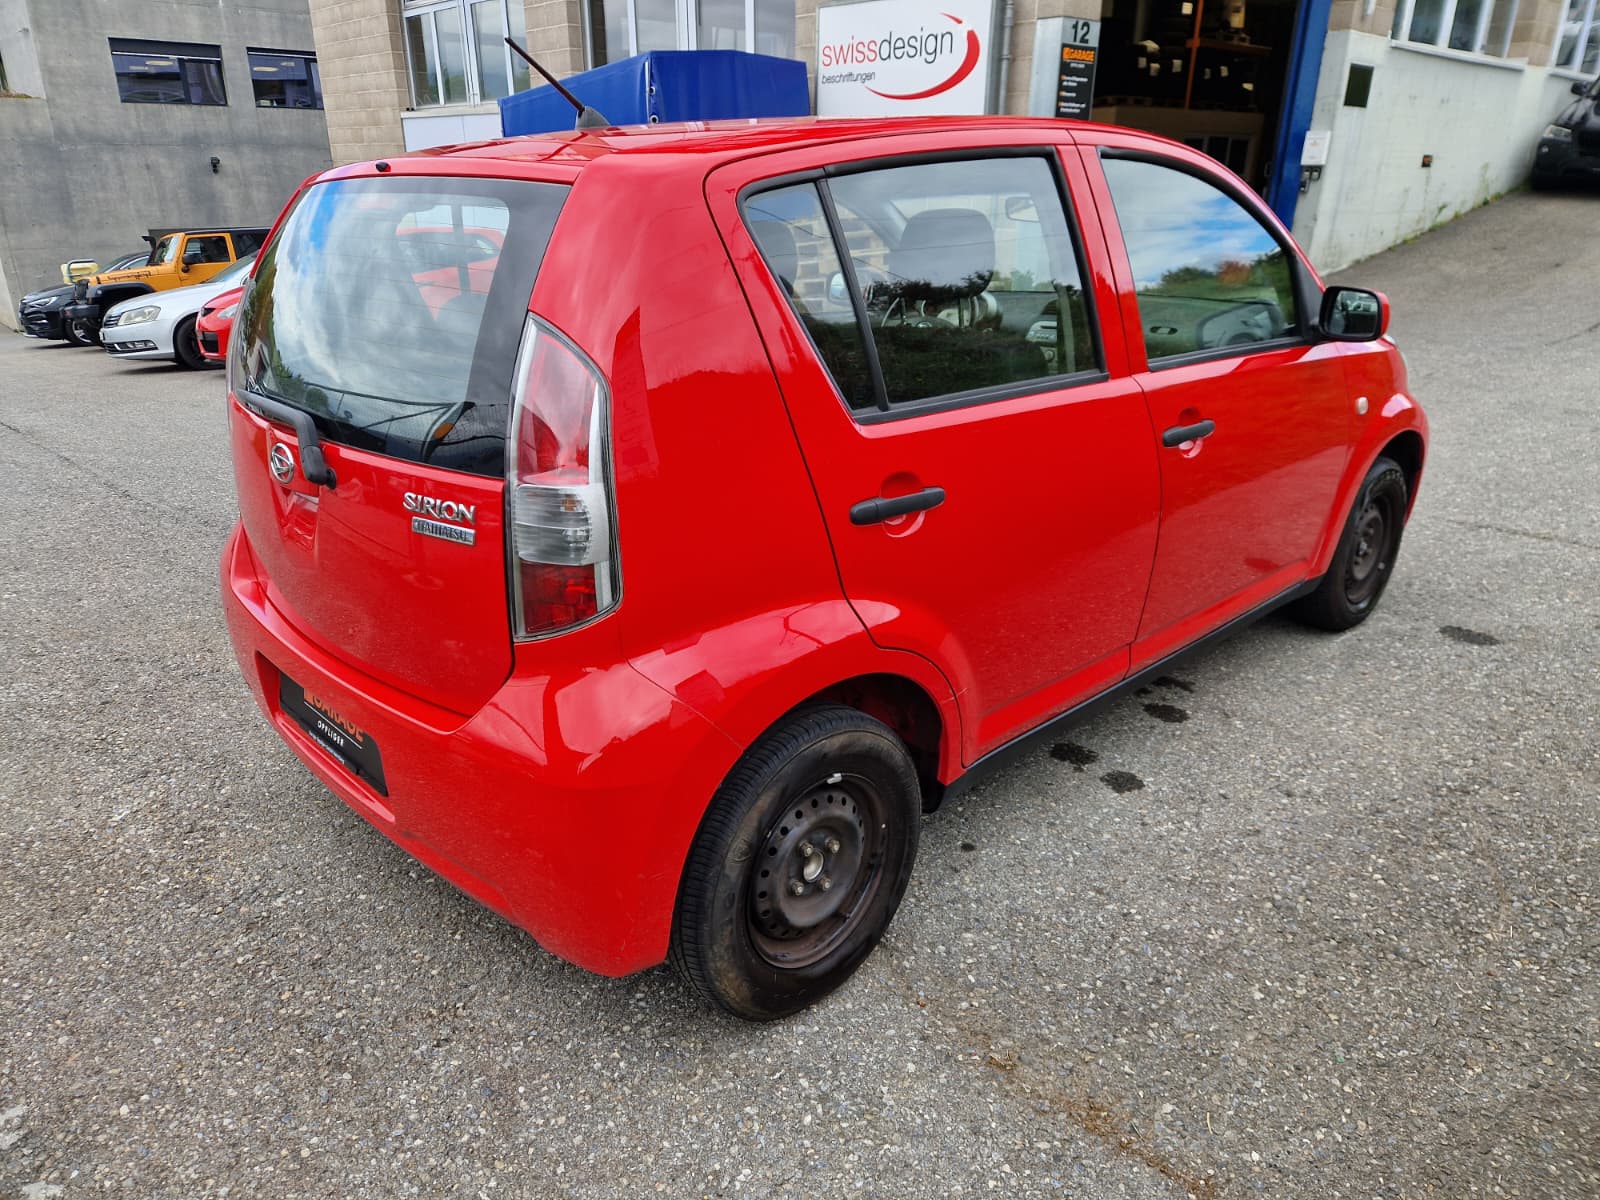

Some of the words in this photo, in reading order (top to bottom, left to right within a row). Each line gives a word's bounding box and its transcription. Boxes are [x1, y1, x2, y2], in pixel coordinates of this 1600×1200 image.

[1072, 20, 1090, 44] 12
[822, 27, 953, 67] swissdesign
[821, 71, 876, 84] beschriftungen
[402, 492, 476, 525] SIRION
[317, 720, 344, 747] OPPLIGER
